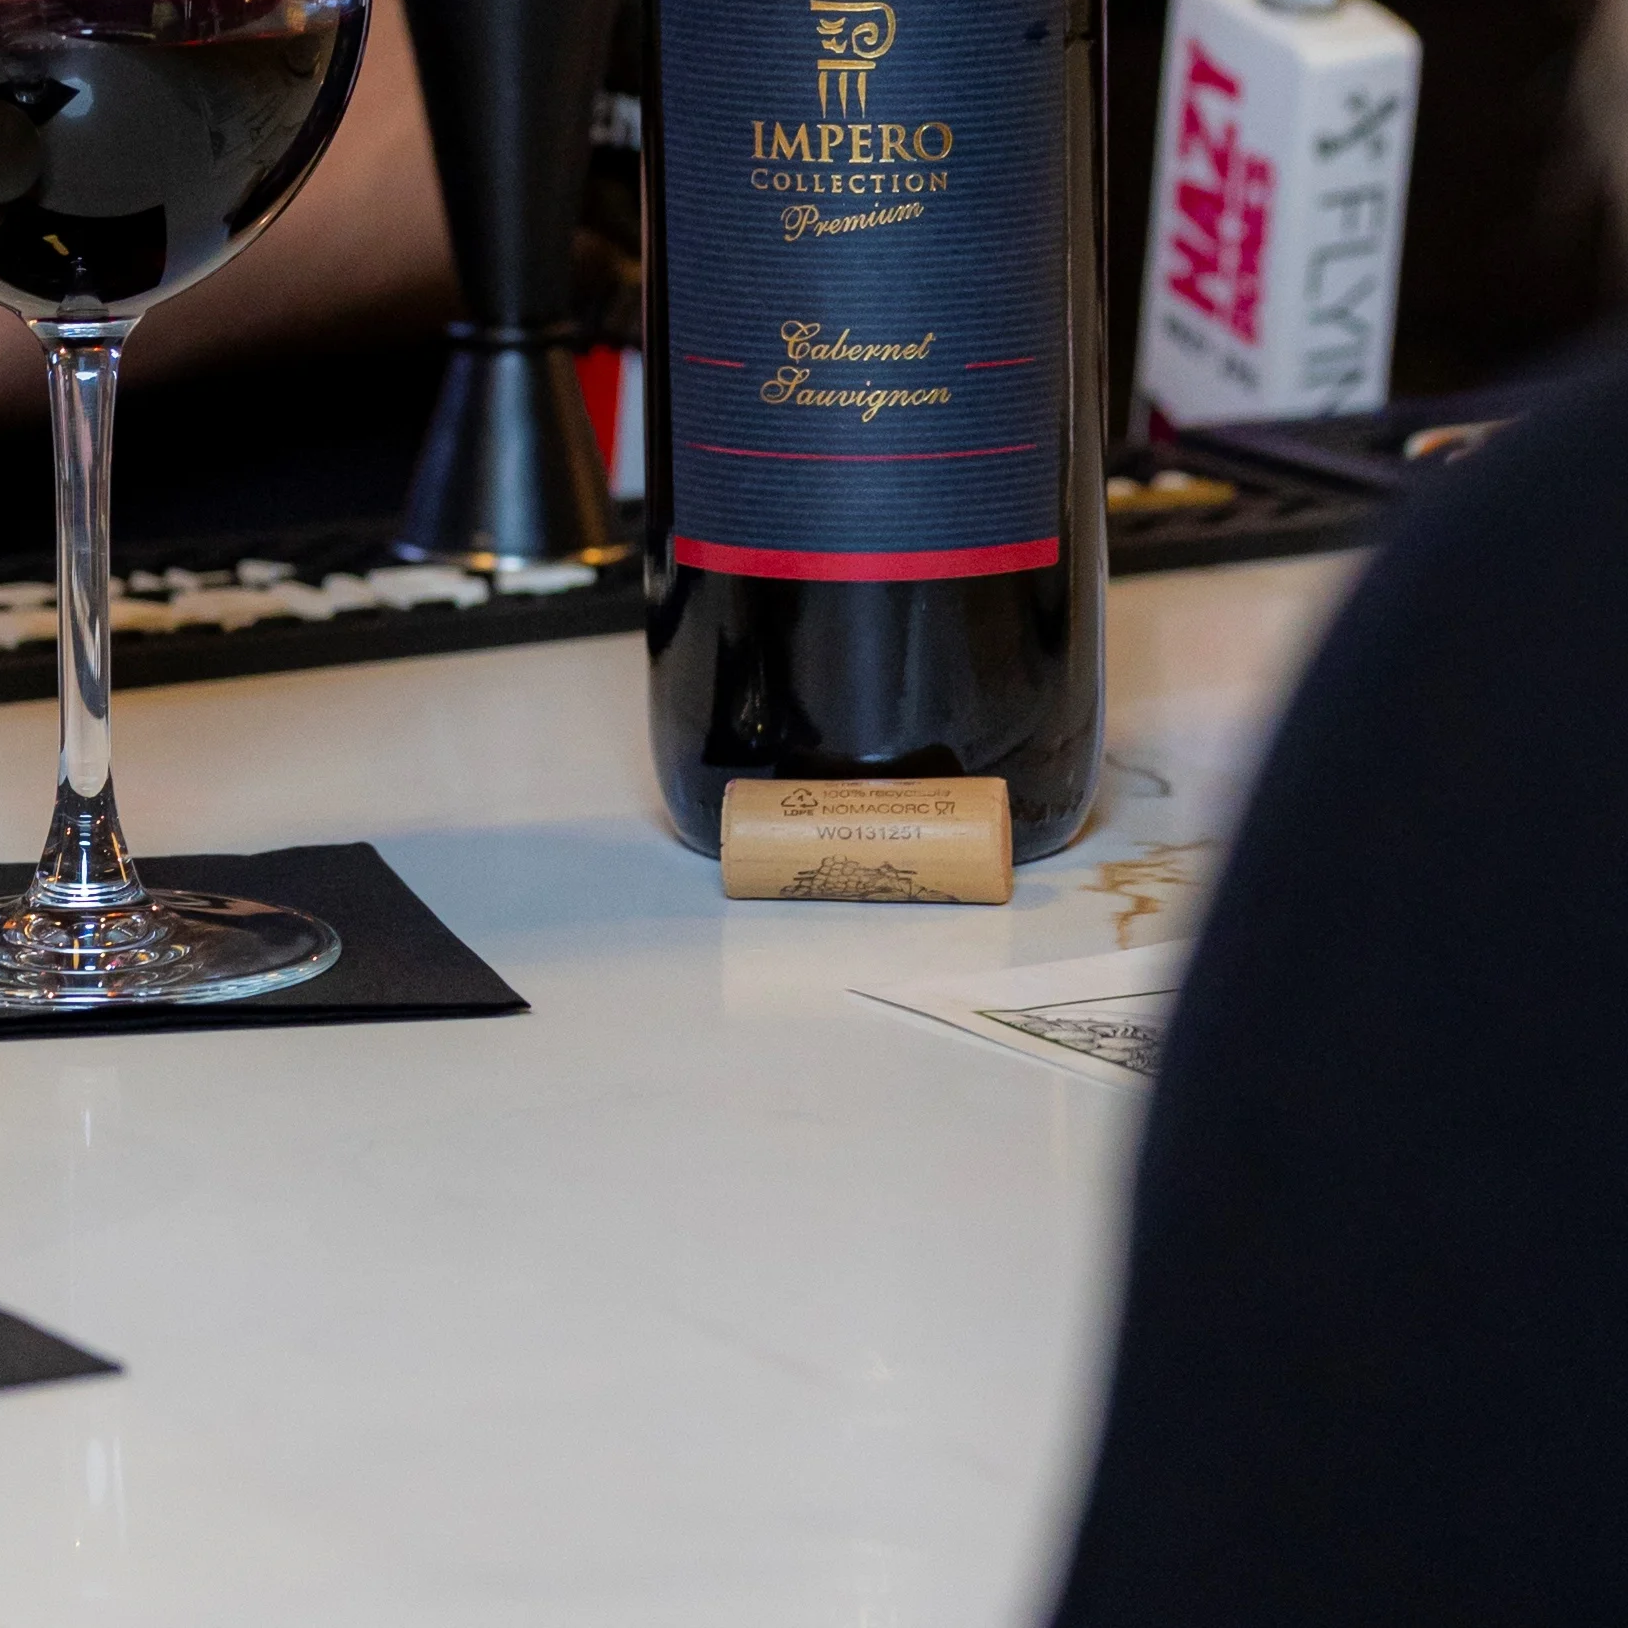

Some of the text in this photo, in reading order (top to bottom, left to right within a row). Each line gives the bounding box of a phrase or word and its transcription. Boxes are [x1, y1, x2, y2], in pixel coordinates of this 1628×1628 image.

[751, 119, 954, 164] IMPERO
[750, 168, 949, 195] COLLECTION
[780, 200, 925, 242] Premium
[780, 320, 937, 363] Cabernet
[759, 365, 952, 422] Sauvignon
[822, 803, 930, 816] NOMACORC
